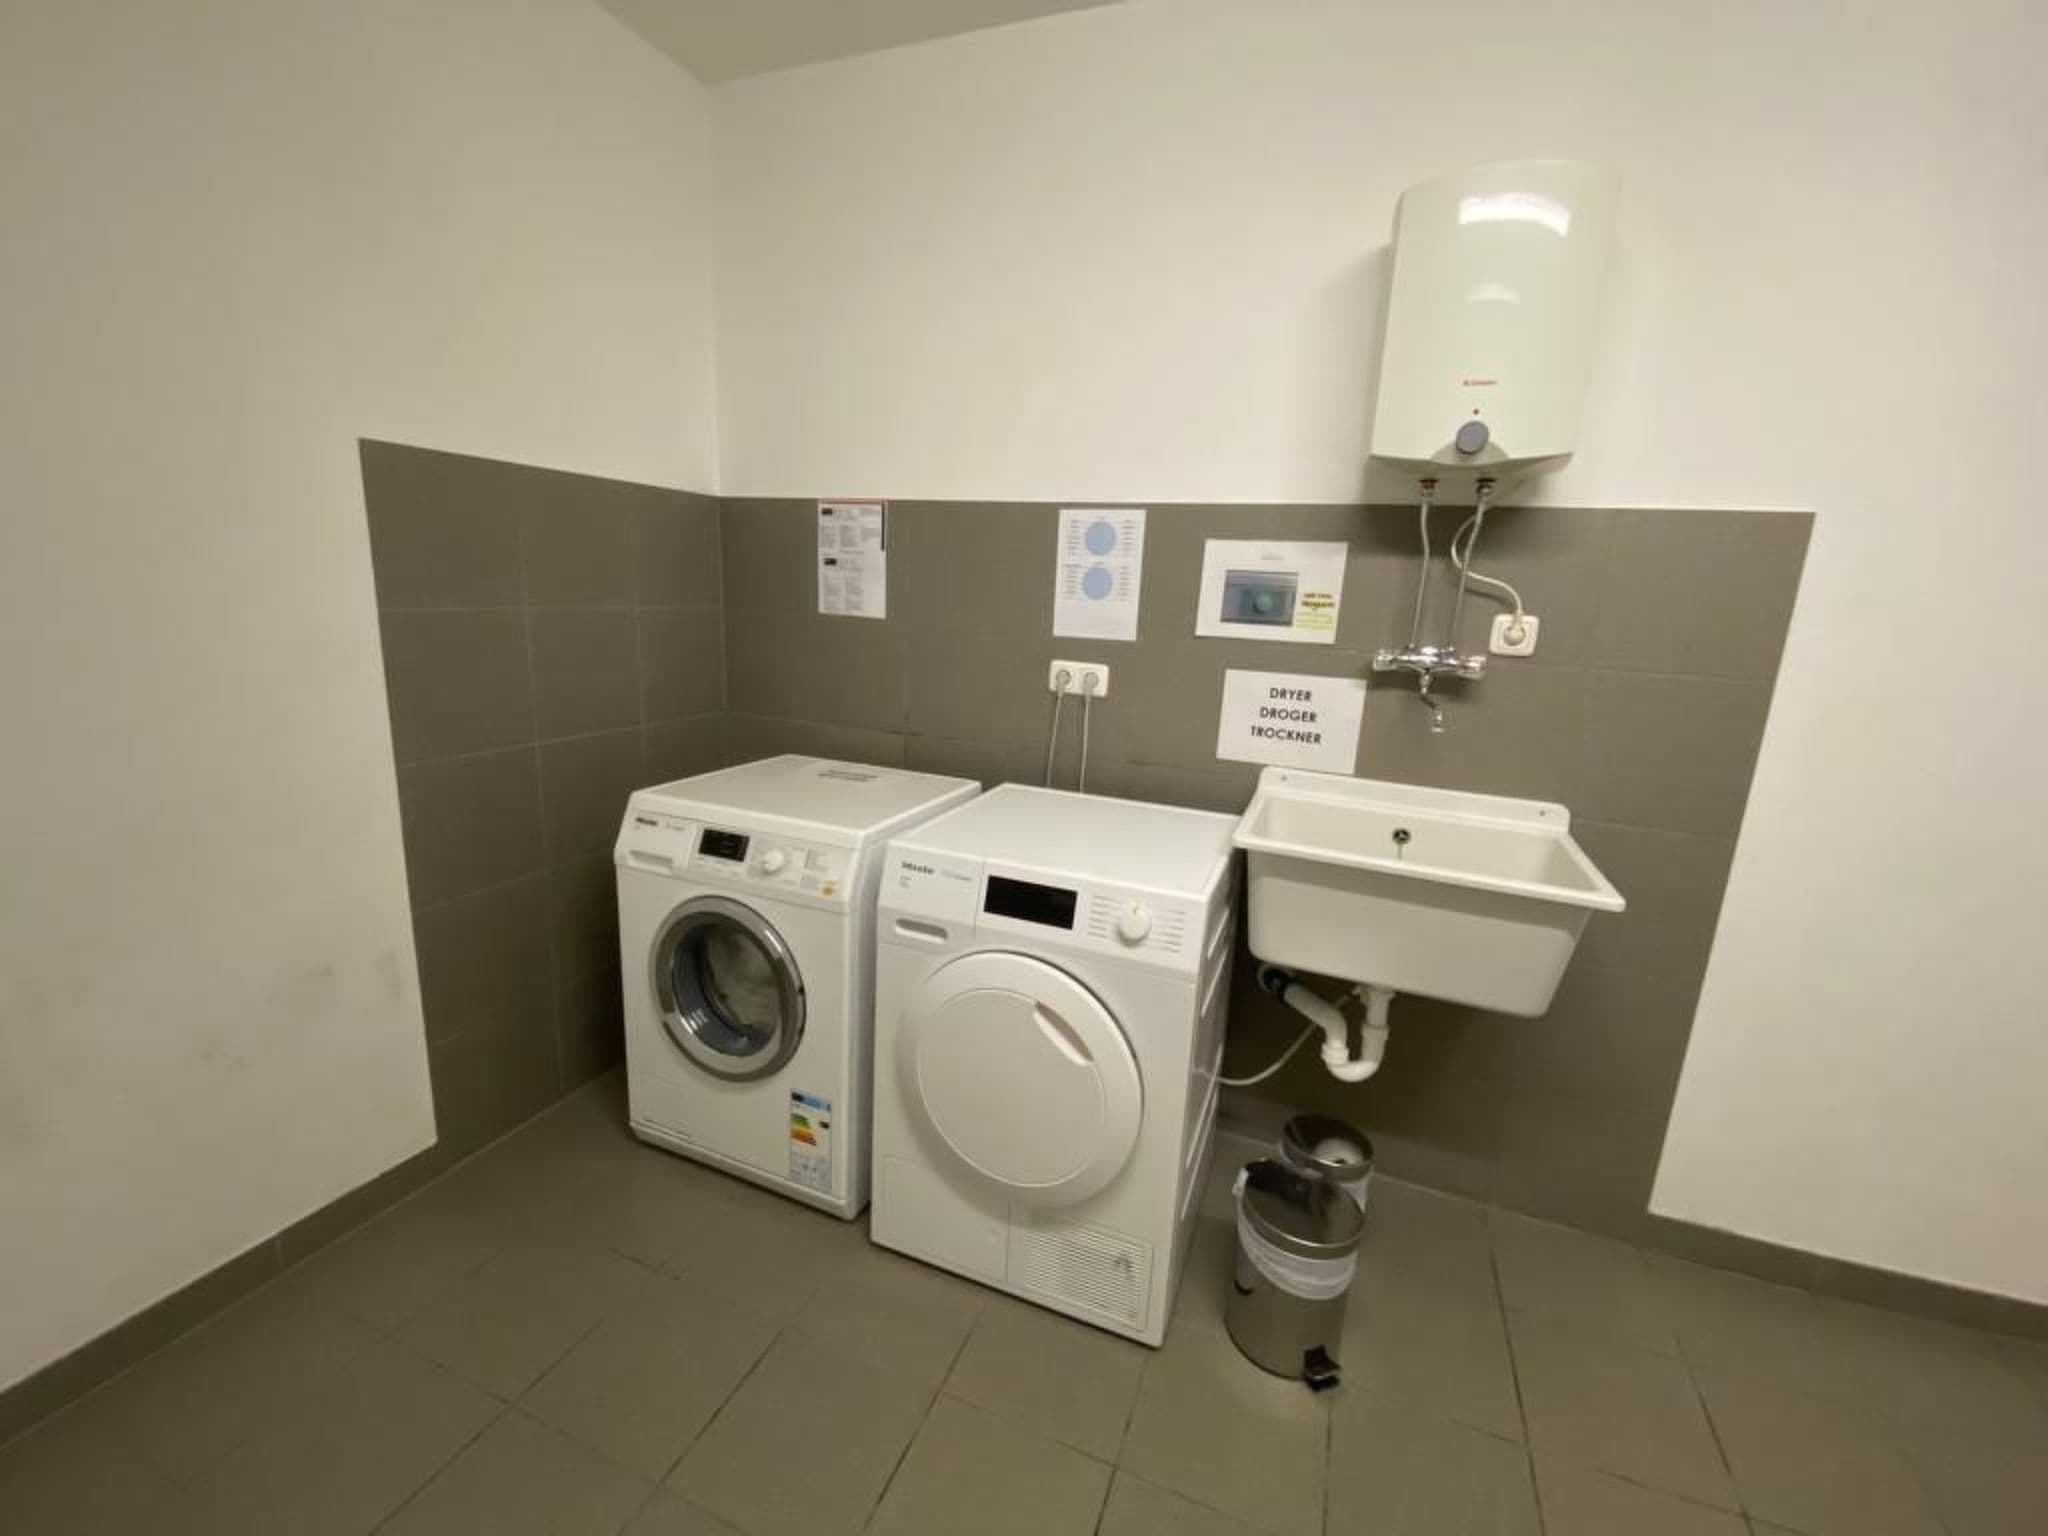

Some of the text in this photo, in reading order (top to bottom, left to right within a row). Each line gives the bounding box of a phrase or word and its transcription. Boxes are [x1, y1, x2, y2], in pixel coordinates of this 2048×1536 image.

[1269, 687, 1312, 701] DRYER
[1260, 706, 1317, 722] DROGER
[1250, 725, 1322, 743] TROCKNER
